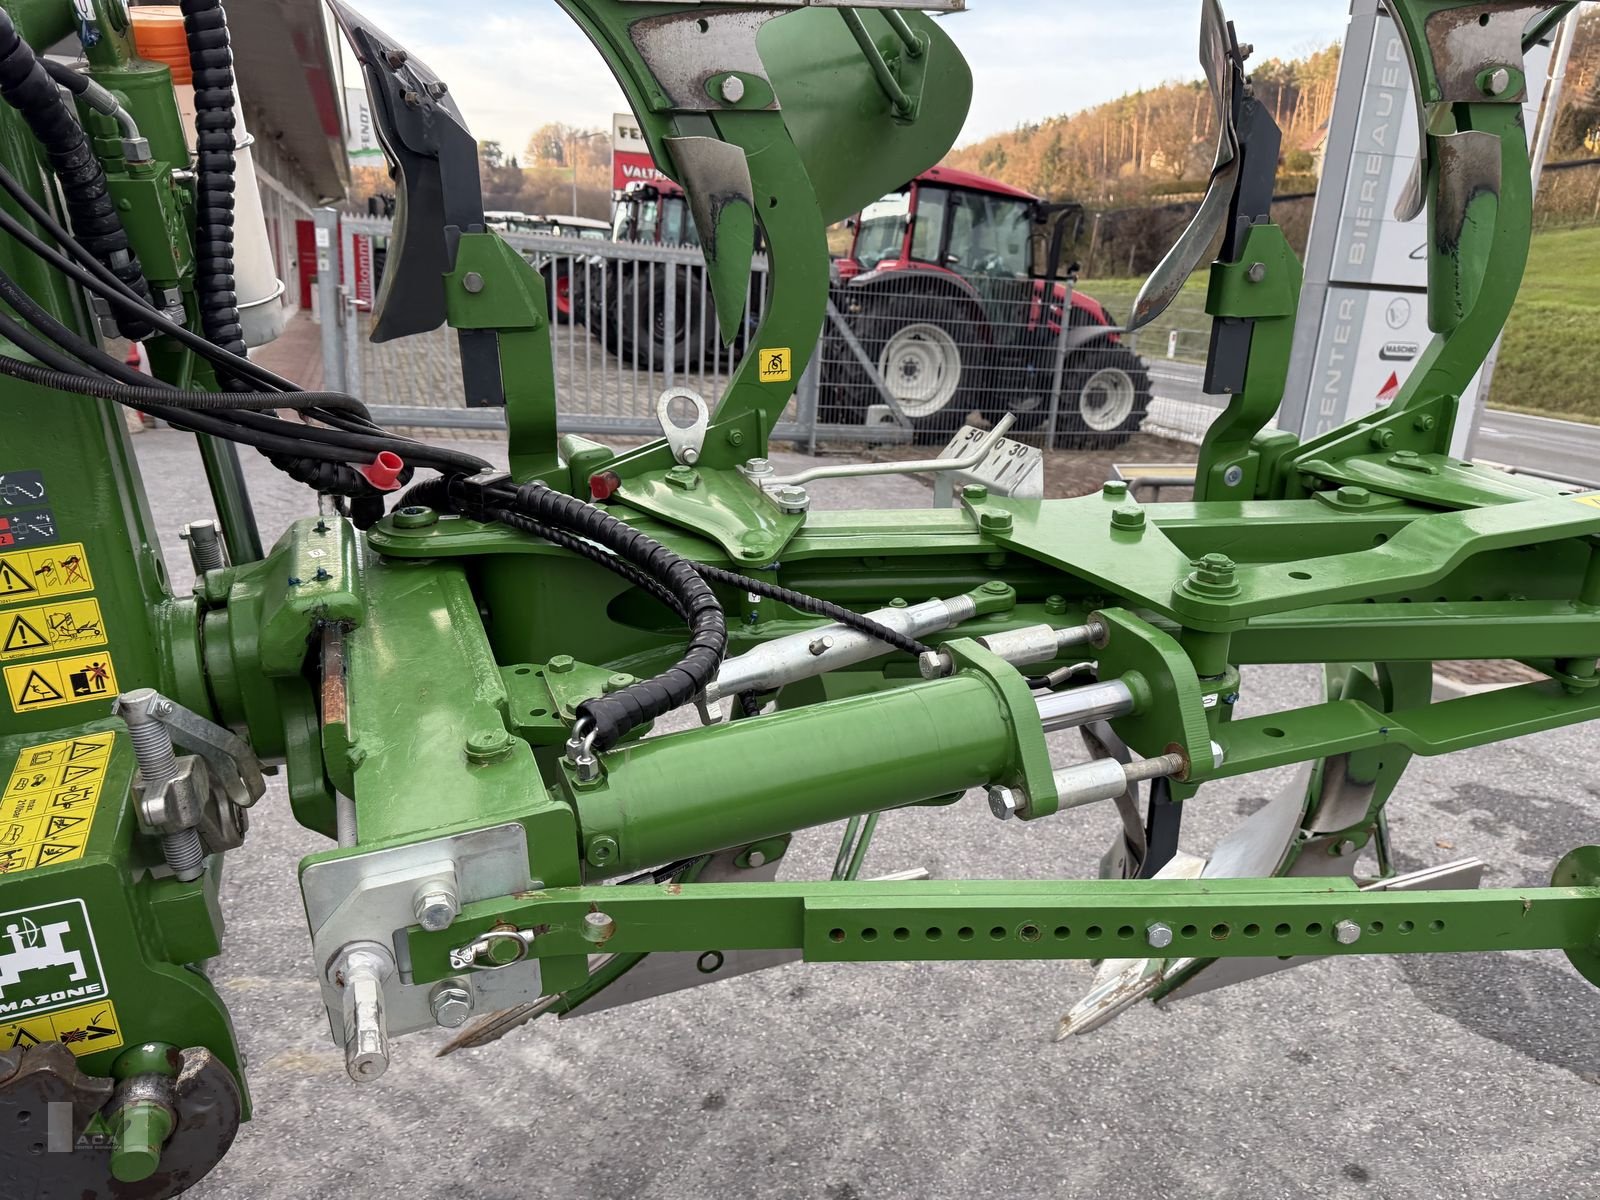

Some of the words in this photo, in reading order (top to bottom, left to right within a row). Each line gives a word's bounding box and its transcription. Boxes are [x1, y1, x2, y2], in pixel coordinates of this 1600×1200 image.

[359, 103, 371, 151] FENDT
[618, 126, 643, 140] FE
[1316, 298, 1355, 434] CENTER
[1349, 37, 1402, 265] BIERBAUER
[965, 428, 985, 443] 50
[1008, 443, 1029, 459] 30
